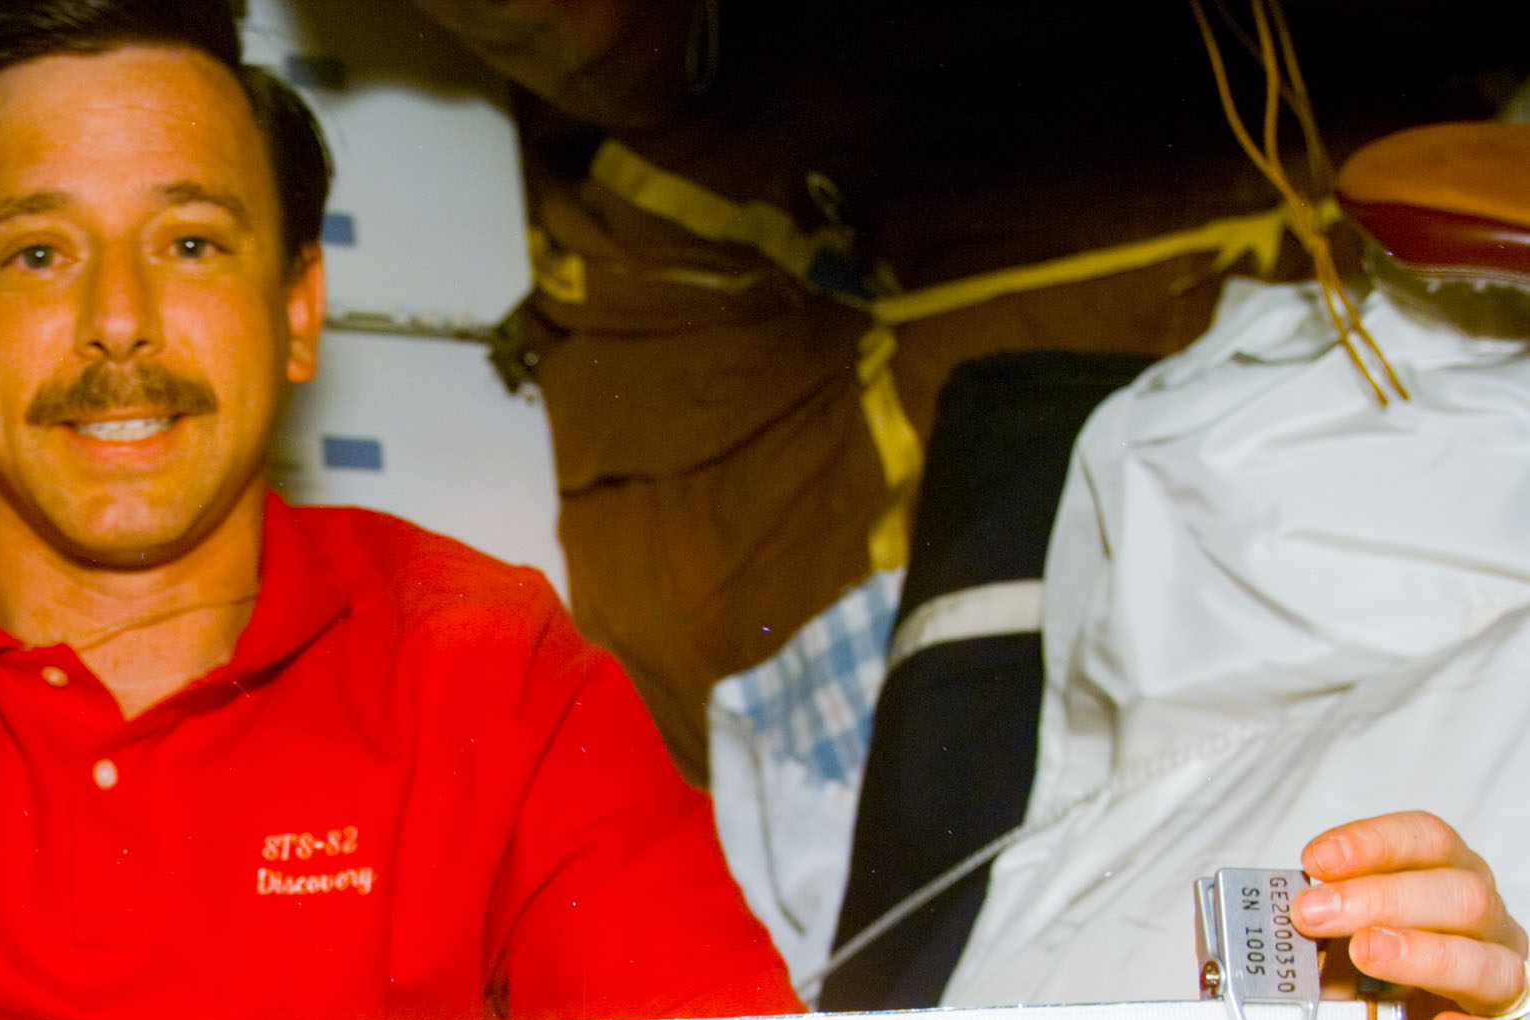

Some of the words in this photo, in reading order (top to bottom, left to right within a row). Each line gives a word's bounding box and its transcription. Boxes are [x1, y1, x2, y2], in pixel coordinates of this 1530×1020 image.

[262, 825, 359, 861] STS-82
[256, 866, 374, 895] Discovery
[1241, 887, 1261, 912] SN
[1244, 926, 1266, 977] 1005
[1269, 876, 1297, 994] GE2000350
